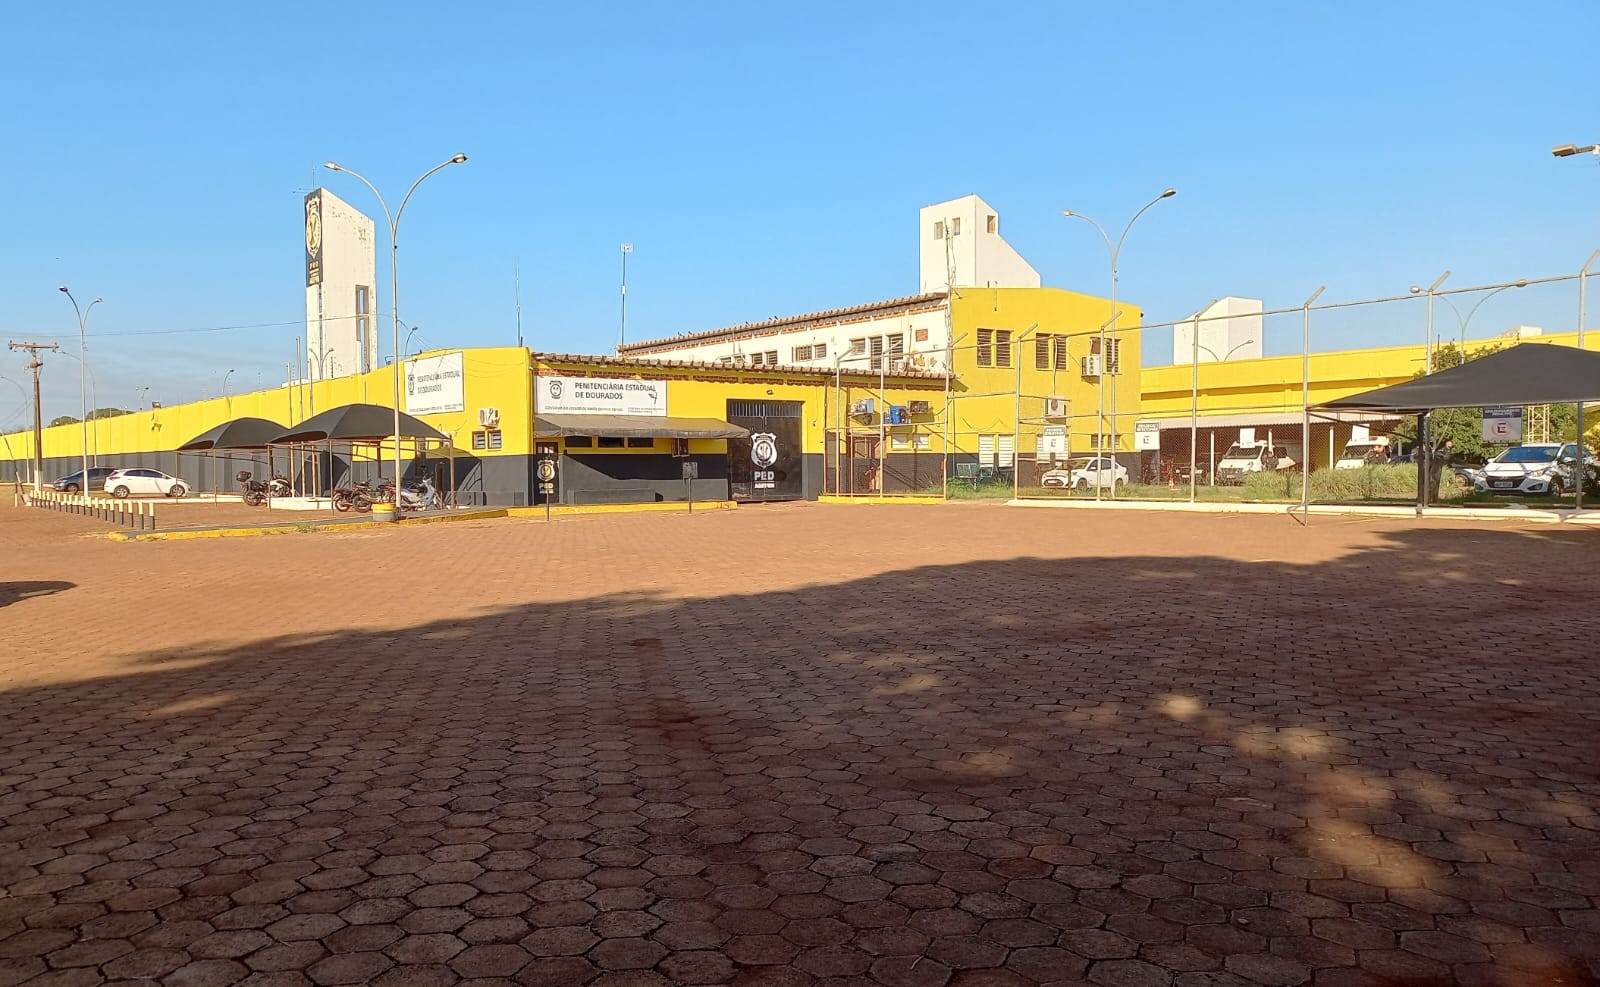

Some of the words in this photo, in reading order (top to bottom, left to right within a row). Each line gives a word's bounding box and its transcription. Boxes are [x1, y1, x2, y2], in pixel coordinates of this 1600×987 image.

[574, 381, 624, 391] PENITENCIÁRIA
[625, 383, 656, 392] ESTADUAL
[575, 391, 585, 399] DE
[585, 391, 623, 400] DOURADOS
[1498, 423, 1507, 433] E
[754, 471, 775, 480] PED
